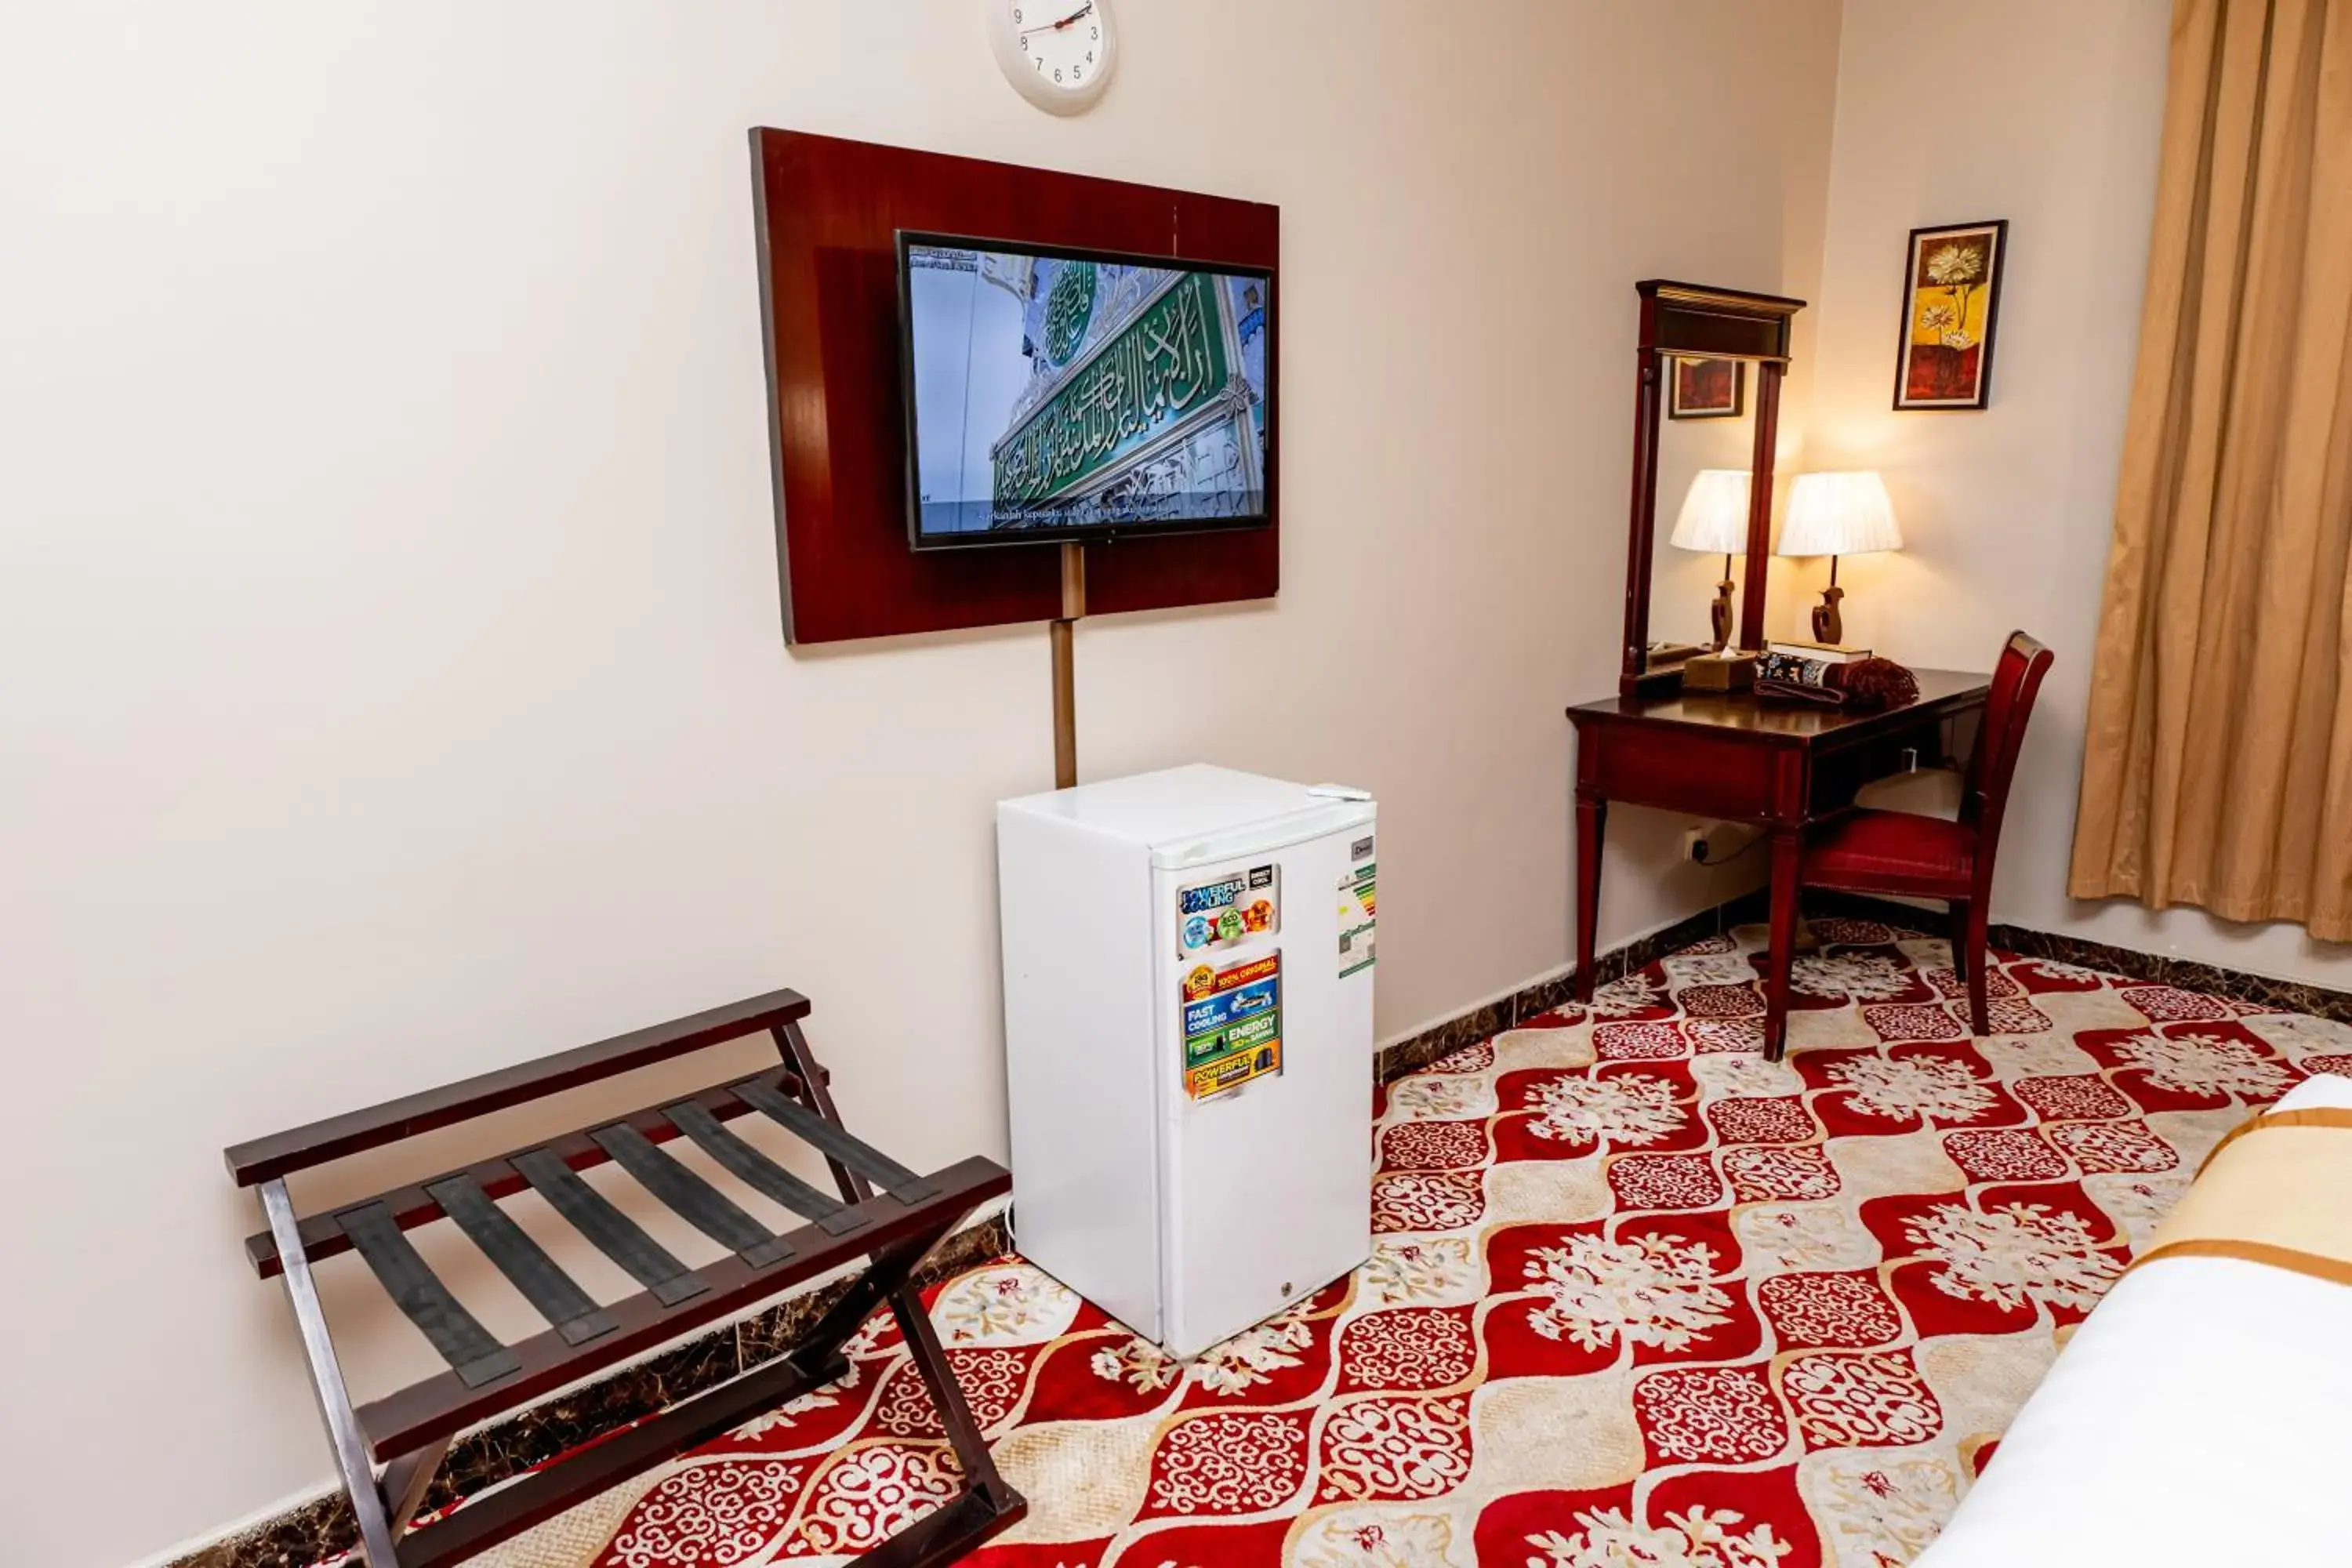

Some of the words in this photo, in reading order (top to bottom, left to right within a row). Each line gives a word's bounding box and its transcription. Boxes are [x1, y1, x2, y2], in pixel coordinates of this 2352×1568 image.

[1014, 9, 1022, 24] 9
[1091, 27, 1098, 40] 3
[1021, 36, 1028, 51] 8
[1036, 57, 1044, 71] 7
[1086, 51, 1092, 64] 4
[1054, 68, 1062, 82] 6
[1073, 65, 1081, 79] 5
[1183, 879, 1245, 902] POWERFUL
[1181, 892, 1234, 914] COOLING
[1222, 914, 1238, 924] ECO
[1188, 1004, 1215, 1022] FAST
[1188, 1012, 1227, 1032] COOLING
[1229, 1014, 1276, 1042] ENERGY
[1193, 1054, 1252, 1083] POWERFUL
